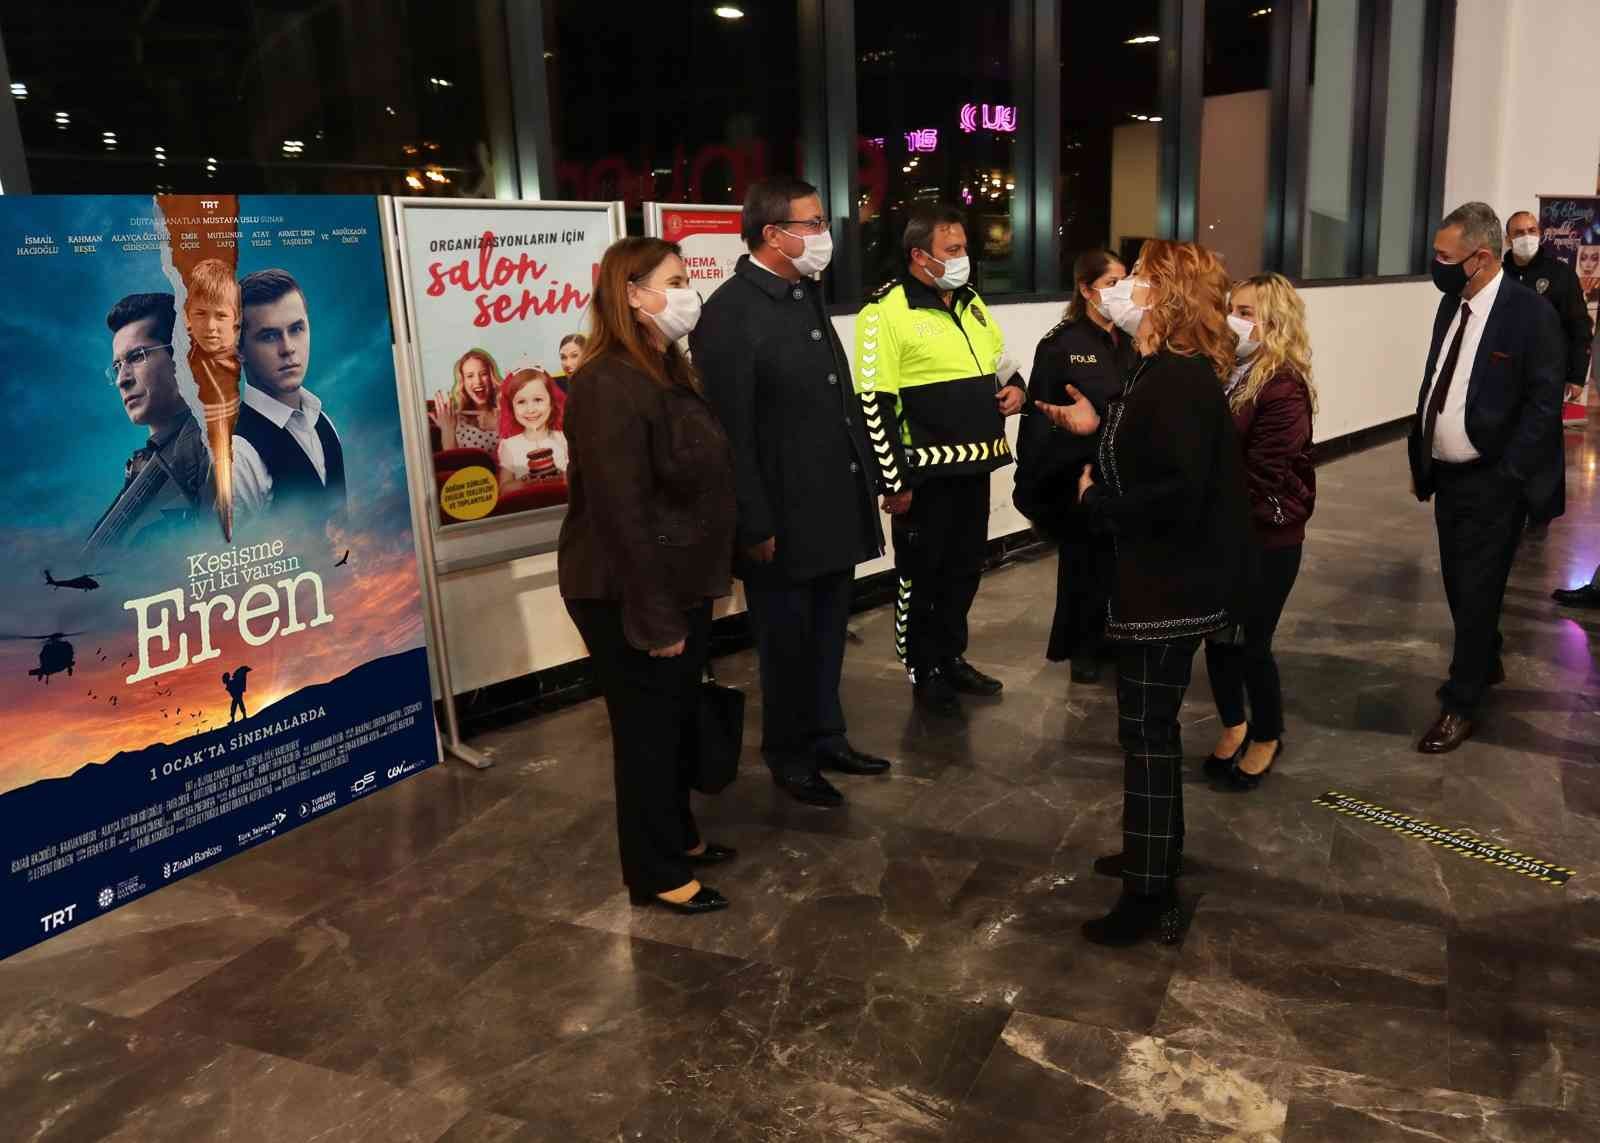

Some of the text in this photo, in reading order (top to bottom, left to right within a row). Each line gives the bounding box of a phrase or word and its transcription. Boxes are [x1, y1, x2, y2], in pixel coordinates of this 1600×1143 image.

[200, 200, 219, 209] TRT
[202, 216, 239, 225] MUSTAFA
[251, 231, 270, 239] ATAY
[561, 228, 585, 246] İÇİN
[427, 231, 548, 297] salon
[684, 257, 717, 268] NEMA
[190, 573, 216, 600] iyi
[219, 567, 239, 589] ki
[123, 570, 334, 684] Eren
[149, 767, 158, 781] 1
[230, 705, 327, 751] SİNEMALARDA
[1335, 798, 1550, 876] Lütfen bu mesafede bekleyiniz
[172, 851, 194, 873] Ziraat
[40, 903, 77, 932] TRT
